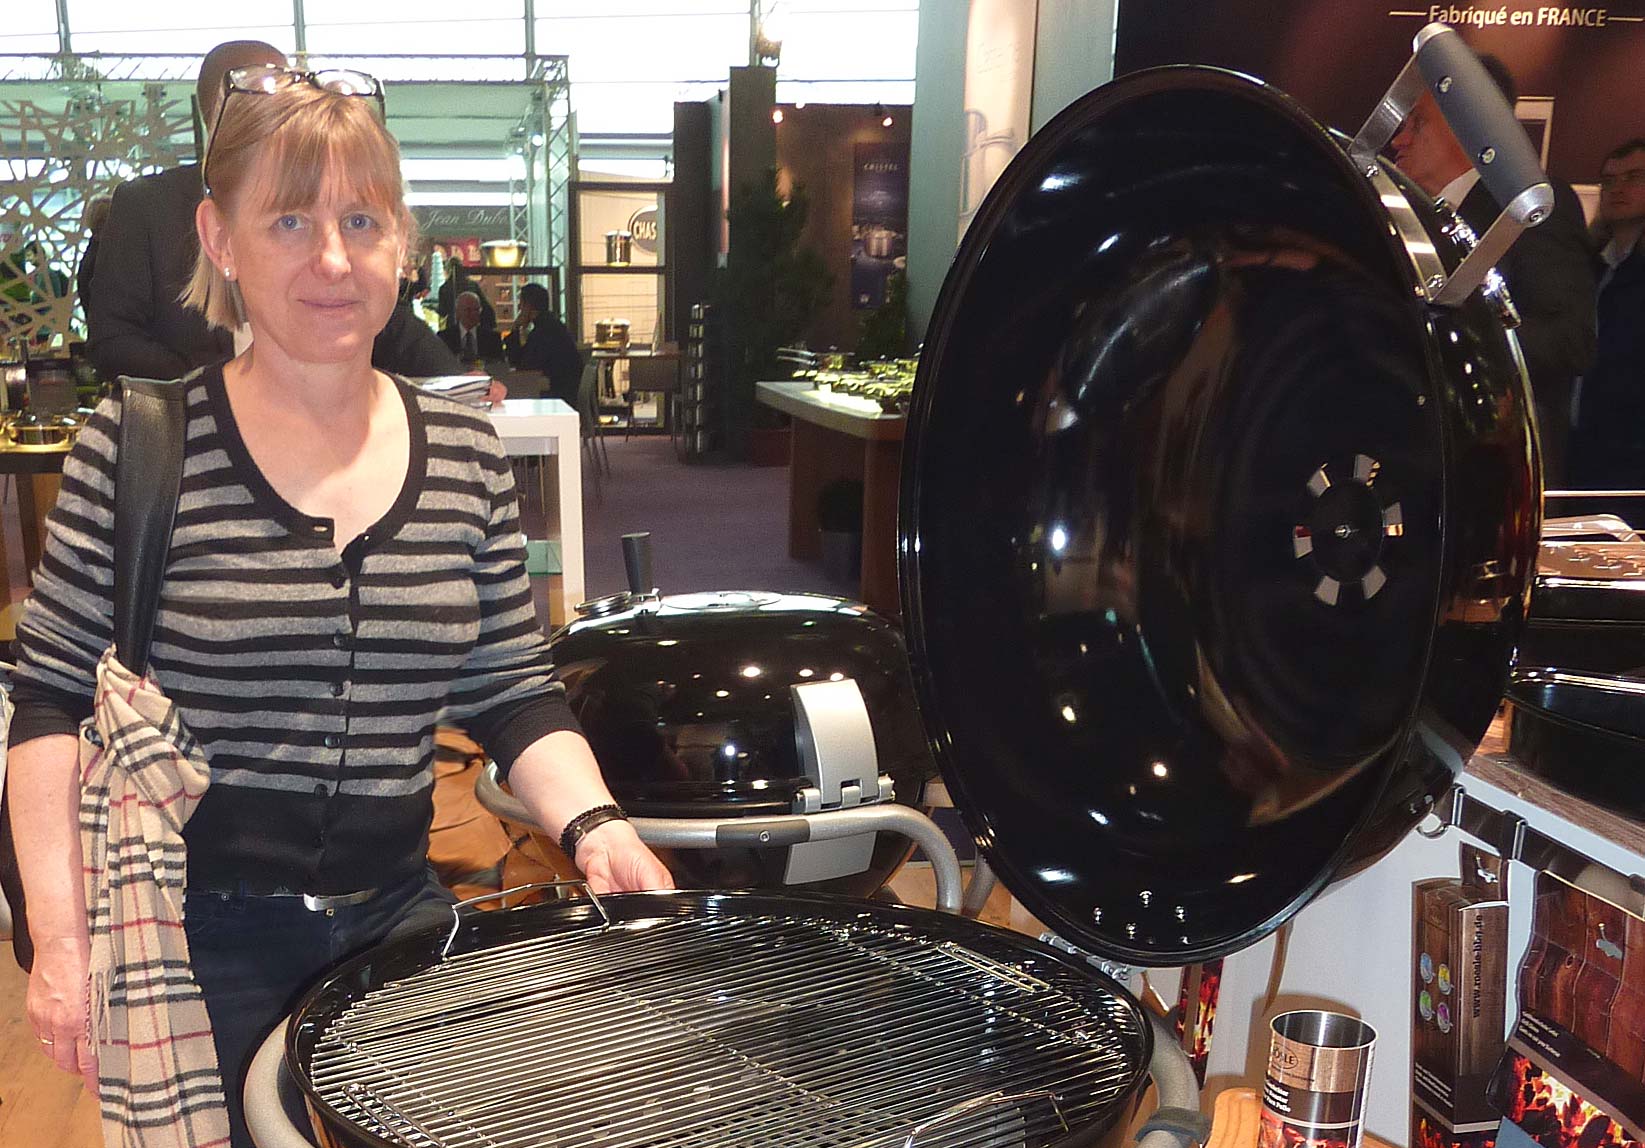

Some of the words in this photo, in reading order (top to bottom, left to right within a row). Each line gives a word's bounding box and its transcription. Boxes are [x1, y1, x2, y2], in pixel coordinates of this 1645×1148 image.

[1428, 5, 1506, 29] Fabriqué
[1510, 11, 1533, 26] en
[1537, 7, 1607, 27] FRANCE
[422, 209, 460, 231] Jean
